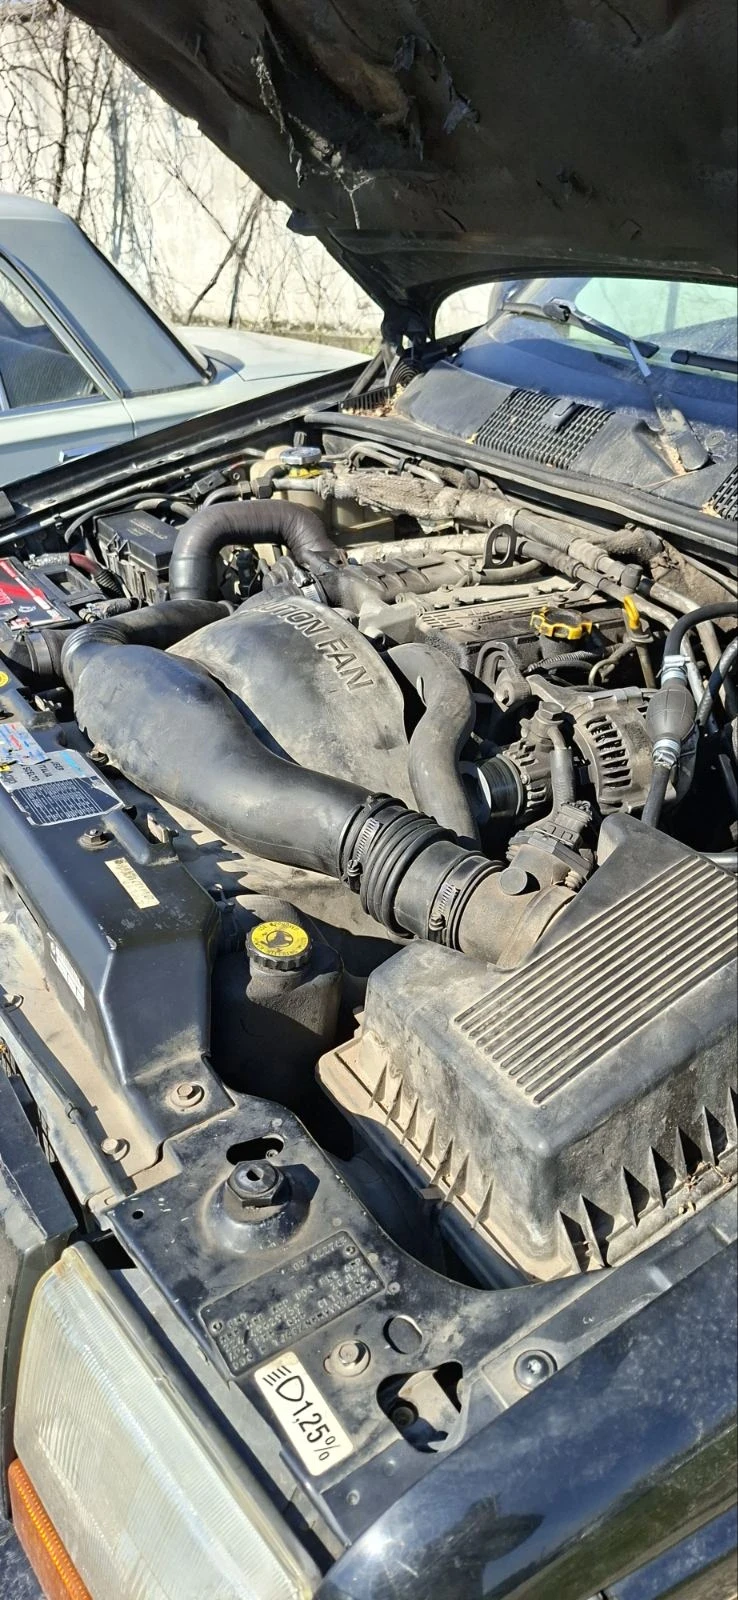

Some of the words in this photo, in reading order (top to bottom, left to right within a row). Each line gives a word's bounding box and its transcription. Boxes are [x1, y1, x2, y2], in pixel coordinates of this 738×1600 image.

[254, 601, 331, 637] UTION
[315, 638, 374, 691] FAN
[293, 1400, 341, 1461] 1,25%
